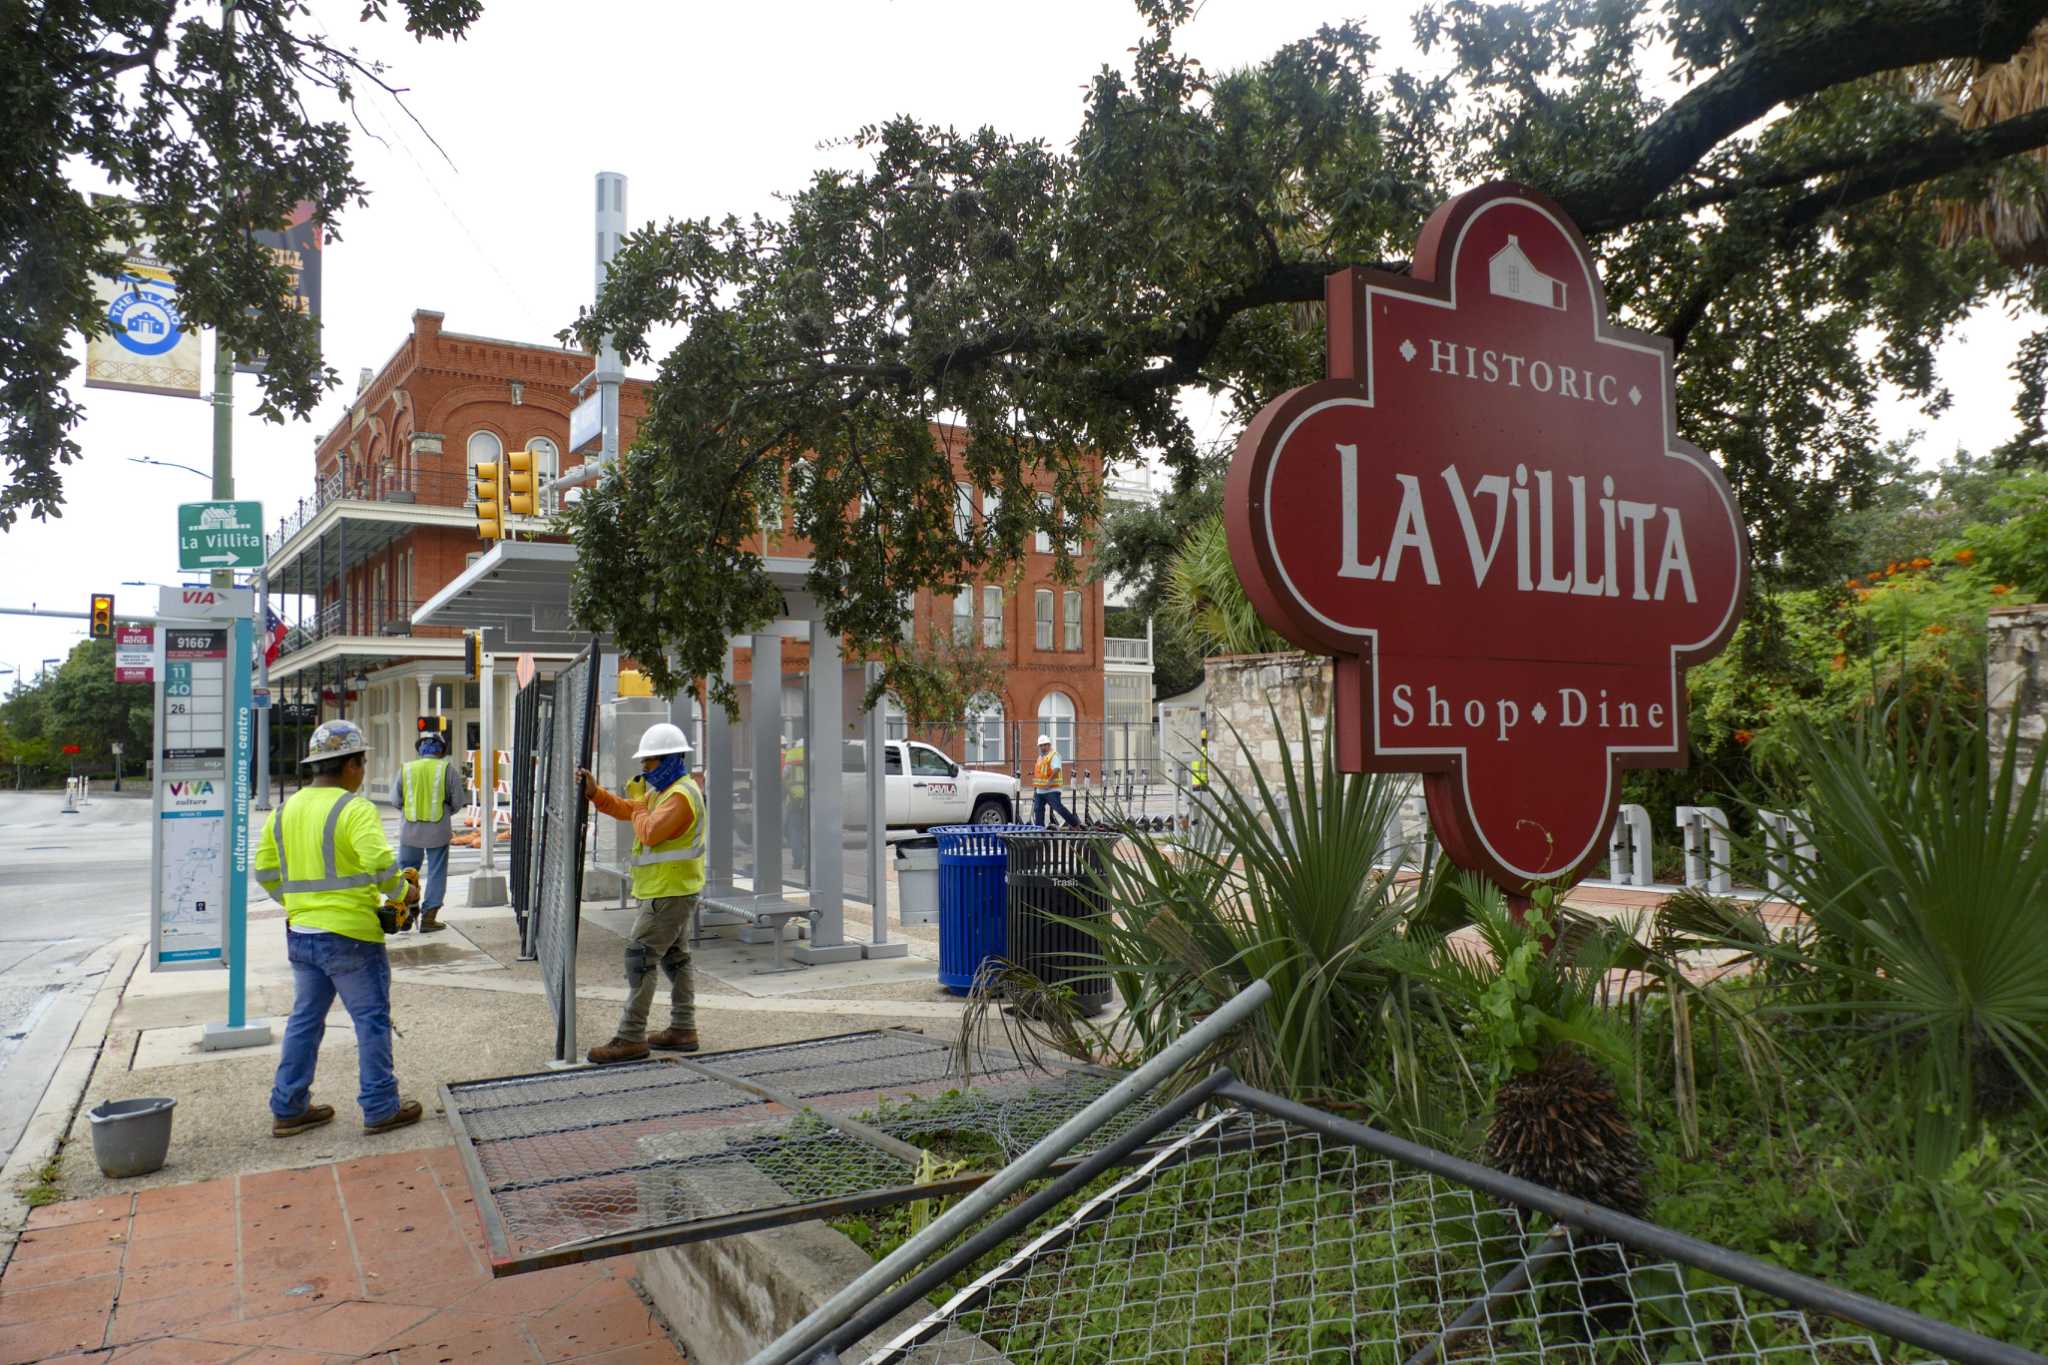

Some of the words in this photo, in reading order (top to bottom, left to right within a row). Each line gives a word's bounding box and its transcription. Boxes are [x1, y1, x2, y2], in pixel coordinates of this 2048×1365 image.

[111, 295, 134, 318] THE
[140, 292, 181, 326] ALAMO
[1428, 338, 1618, 406] HISTORIC
[1335, 443, 1441, 586] LA
[181, 537, 199, 550] La
[206, 533, 261, 548] Villita
[182, 591, 216, 605] VIA
[177, 637, 212, 649] 91667
[172, 667, 187, 679] 11
[167, 684, 191, 696] 40
[170, 703, 186, 715] 26
[1392, 683, 1520, 741] Shop
[1558, 688, 1665, 729] Dine
[236, 706, 249, 750] centro
[235, 759, 248, 815] missions
[928, 784, 957, 794] DAVILA
[175, 799, 208, 808] culture
[233, 825, 246, 872] culture
[1051, 877, 1079, 888] Trash
